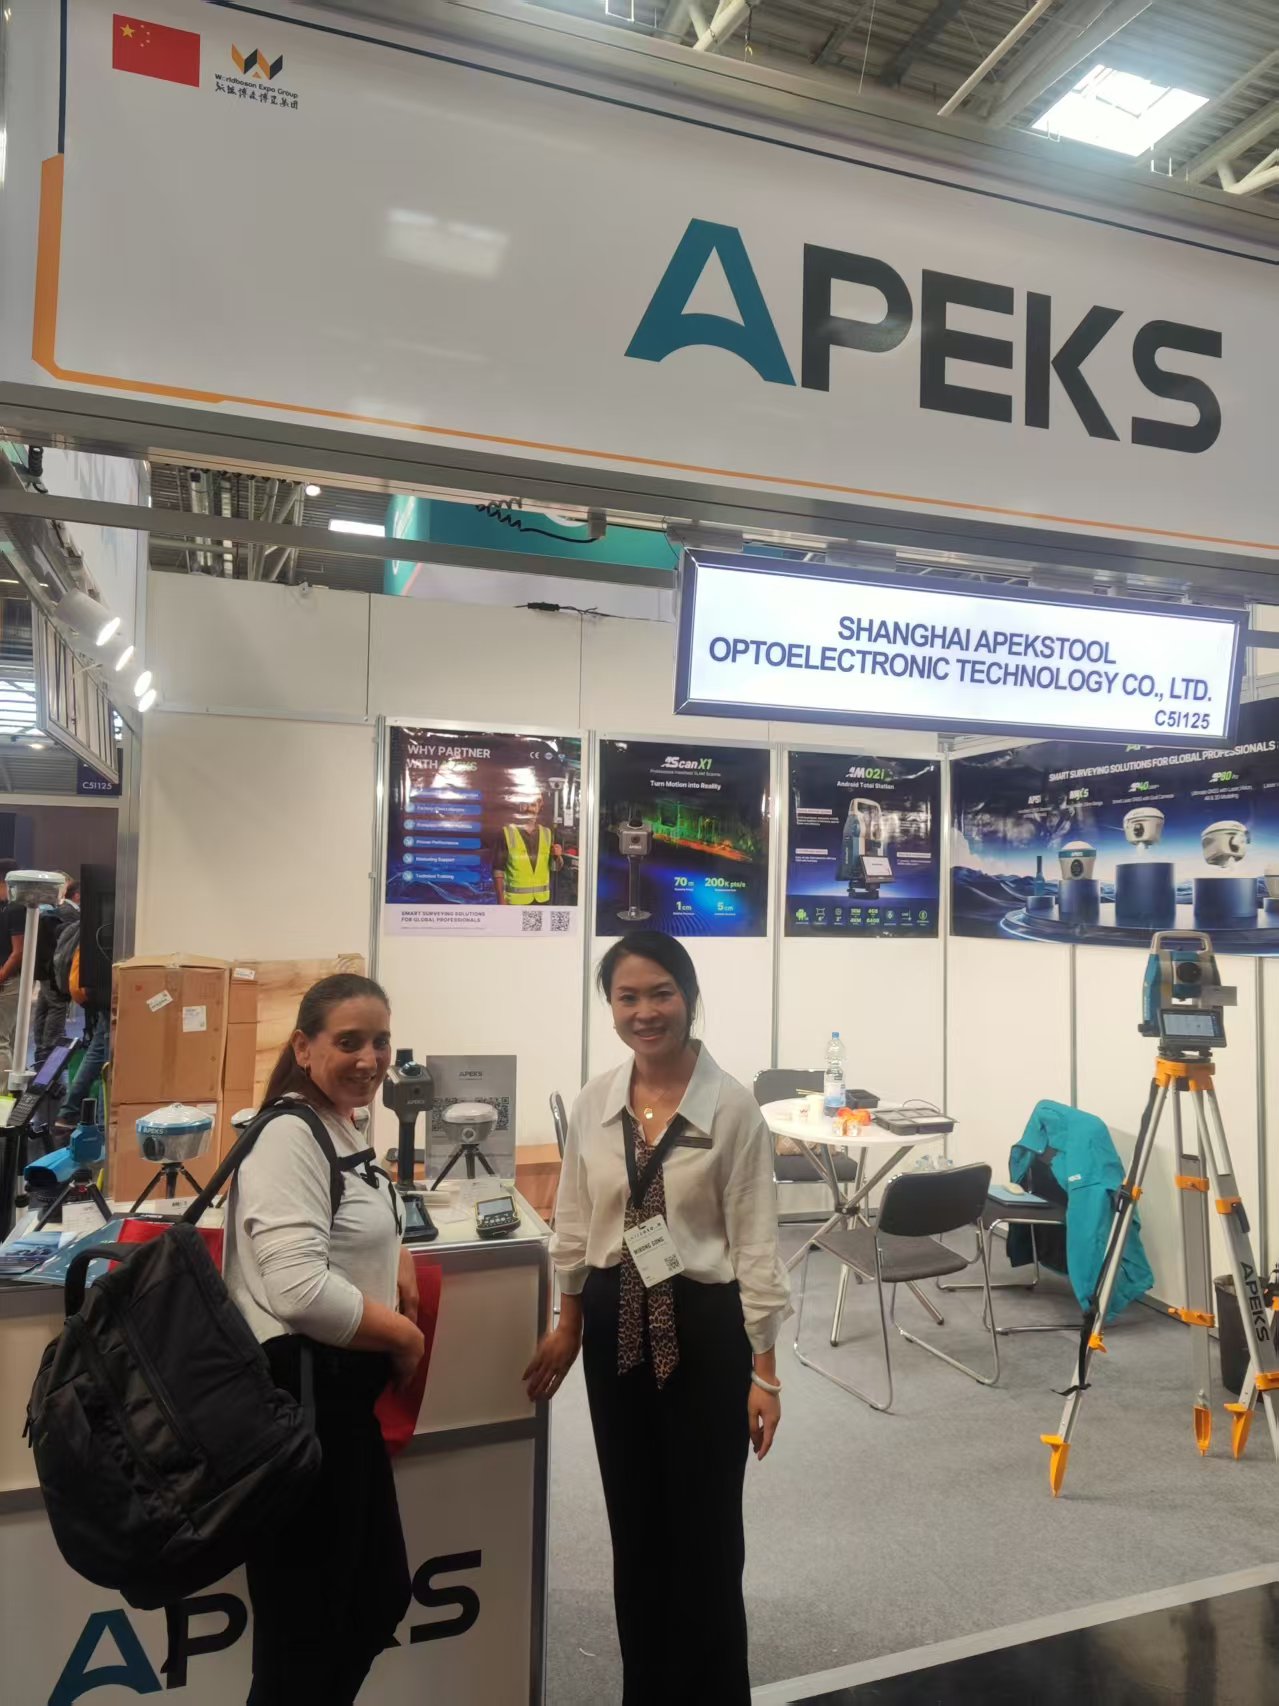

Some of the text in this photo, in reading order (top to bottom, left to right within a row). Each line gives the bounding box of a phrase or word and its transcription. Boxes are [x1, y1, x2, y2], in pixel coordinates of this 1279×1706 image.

[258, 83, 276, 94] Expo
[277, 88, 298, 99] Group
[624, 217, 1222, 454] APEKS
[838, 615, 1116, 665] SHANGHAI APEKSTOOL
[709, 636, 1213, 704] OPTOELECTRONIC TECHNOLOGY CO., LTD.
[406, 758, 438, 769] WITH
[407, 745, 491, 759] WHY PARTNER
[1048, 771, 1070, 782] SMART
[1069, 765, 1110, 779] SURVEYING
[1110, 760, 1152, 774] SOLUTIONS
[1152, 757, 1169, 767] FOR
[1169, 752, 1202, 765] GLOBAL
[700, 782, 721, 791] Reality
[836, 780, 859, 788] Android
[875, 782, 894, 790] Station
[143, 1127, 164, 1135] APEKS
[1240, 1261, 1270, 1343] APEKS
[48, 1549, 482, 1706] APS
